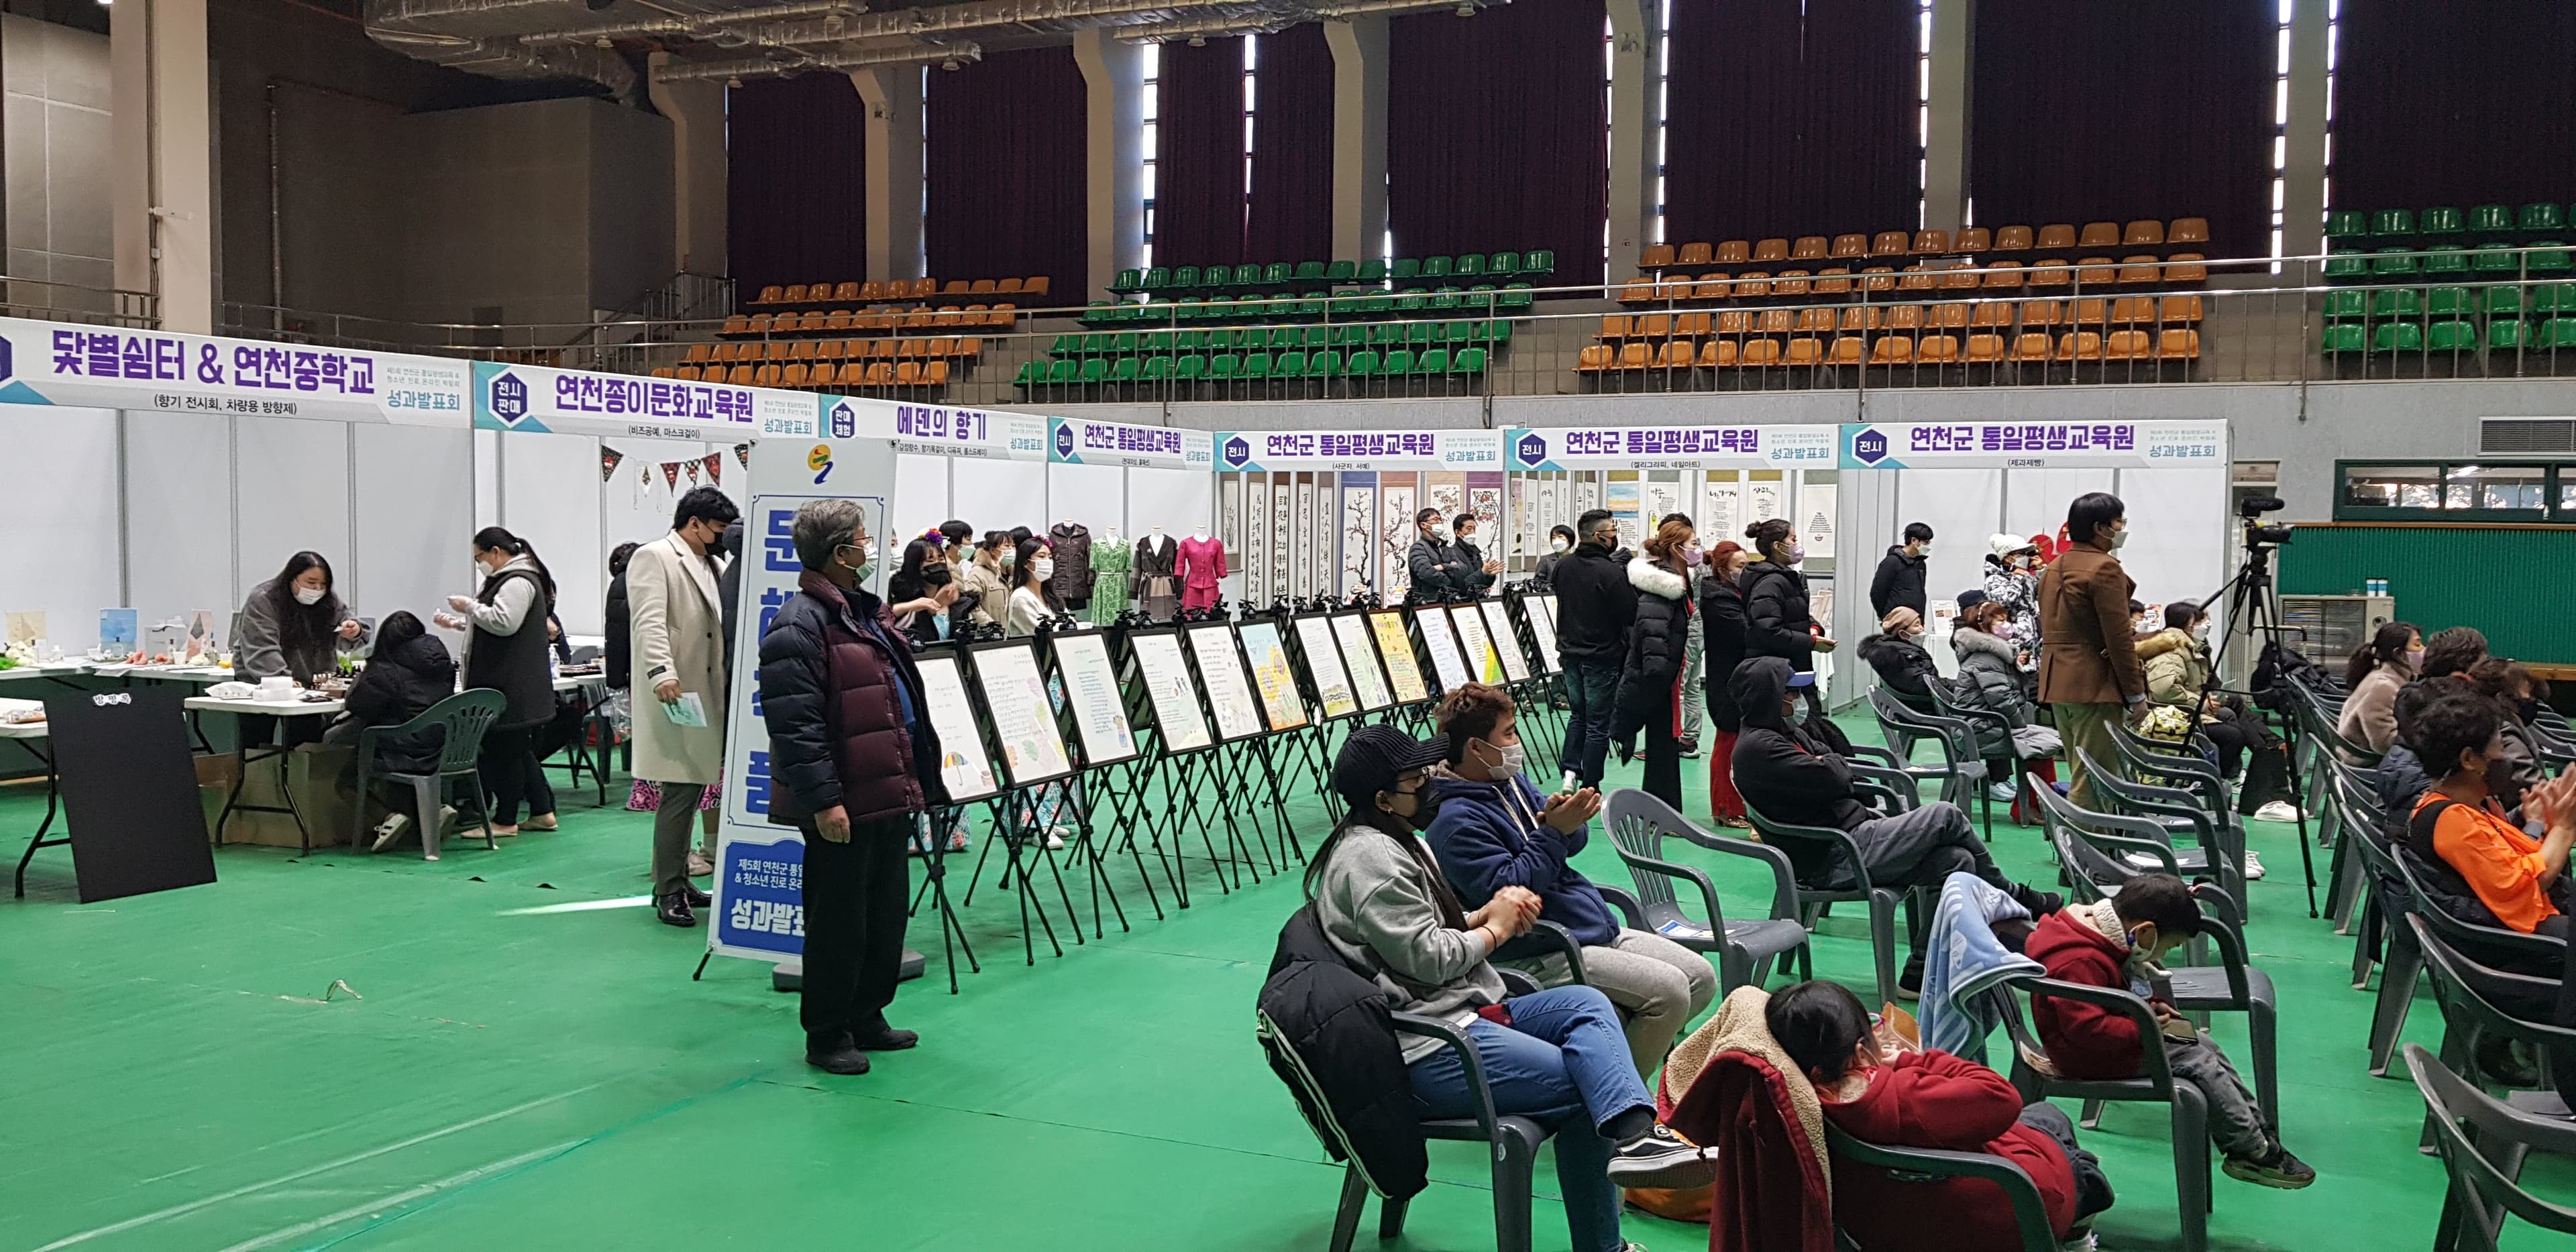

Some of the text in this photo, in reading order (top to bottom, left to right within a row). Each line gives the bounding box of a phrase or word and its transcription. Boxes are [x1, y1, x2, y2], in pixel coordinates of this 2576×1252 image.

[53, 330, 375, 395] 닻별쉼터 & 연천중학교
[498, 382, 521, 396] 전시
[154, 394, 297, 414] (향기 전시회, 차량용 방향제)
[387, 390, 460, 410] 성과발표회
[498, 398, 521, 414] 판매
[555, 374, 753, 423] 연천종이문화교육원
[835, 410, 851, 422] 판매
[897, 406, 986, 440] 에덴의 향기
[629, 424, 700, 439] (비즈공예, 마스크걸이)
[764, 418, 812, 435] 성과발표회
[1010, 437, 1042, 450] 성과발표회
[1085, 424, 1181, 453] 연천군 통일평생교육원
[1267, 435, 1313, 456] 연천군
[1320, 434, 1434, 456] 통일평생교육원
[1566, 431, 1619, 454] 연천군
[1627, 429, 1758, 454] 통일평생교육원
[1911, 426, 1973, 451] 연천군
[1982, 425, 2134, 451] 통일평생교육원
[1228, 446, 1246, 458] 전시
[1446, 450, 1495, 461] 성과발표회
[1522, 445, 1542, 456] 전시
[1771, 447, 1829, 459] 성과발표회
[1860, 441, 1882, 454] 전시
[2149, 445, 2215, 457] 성과발표회
[738, 858, 761, 872] 제5회
[763, 860, 788, 876] 연천군
[735, 872, 742, 883] &
[743, 873, 769, 887] 청소년
[770, 876, 788, 889] 진로
